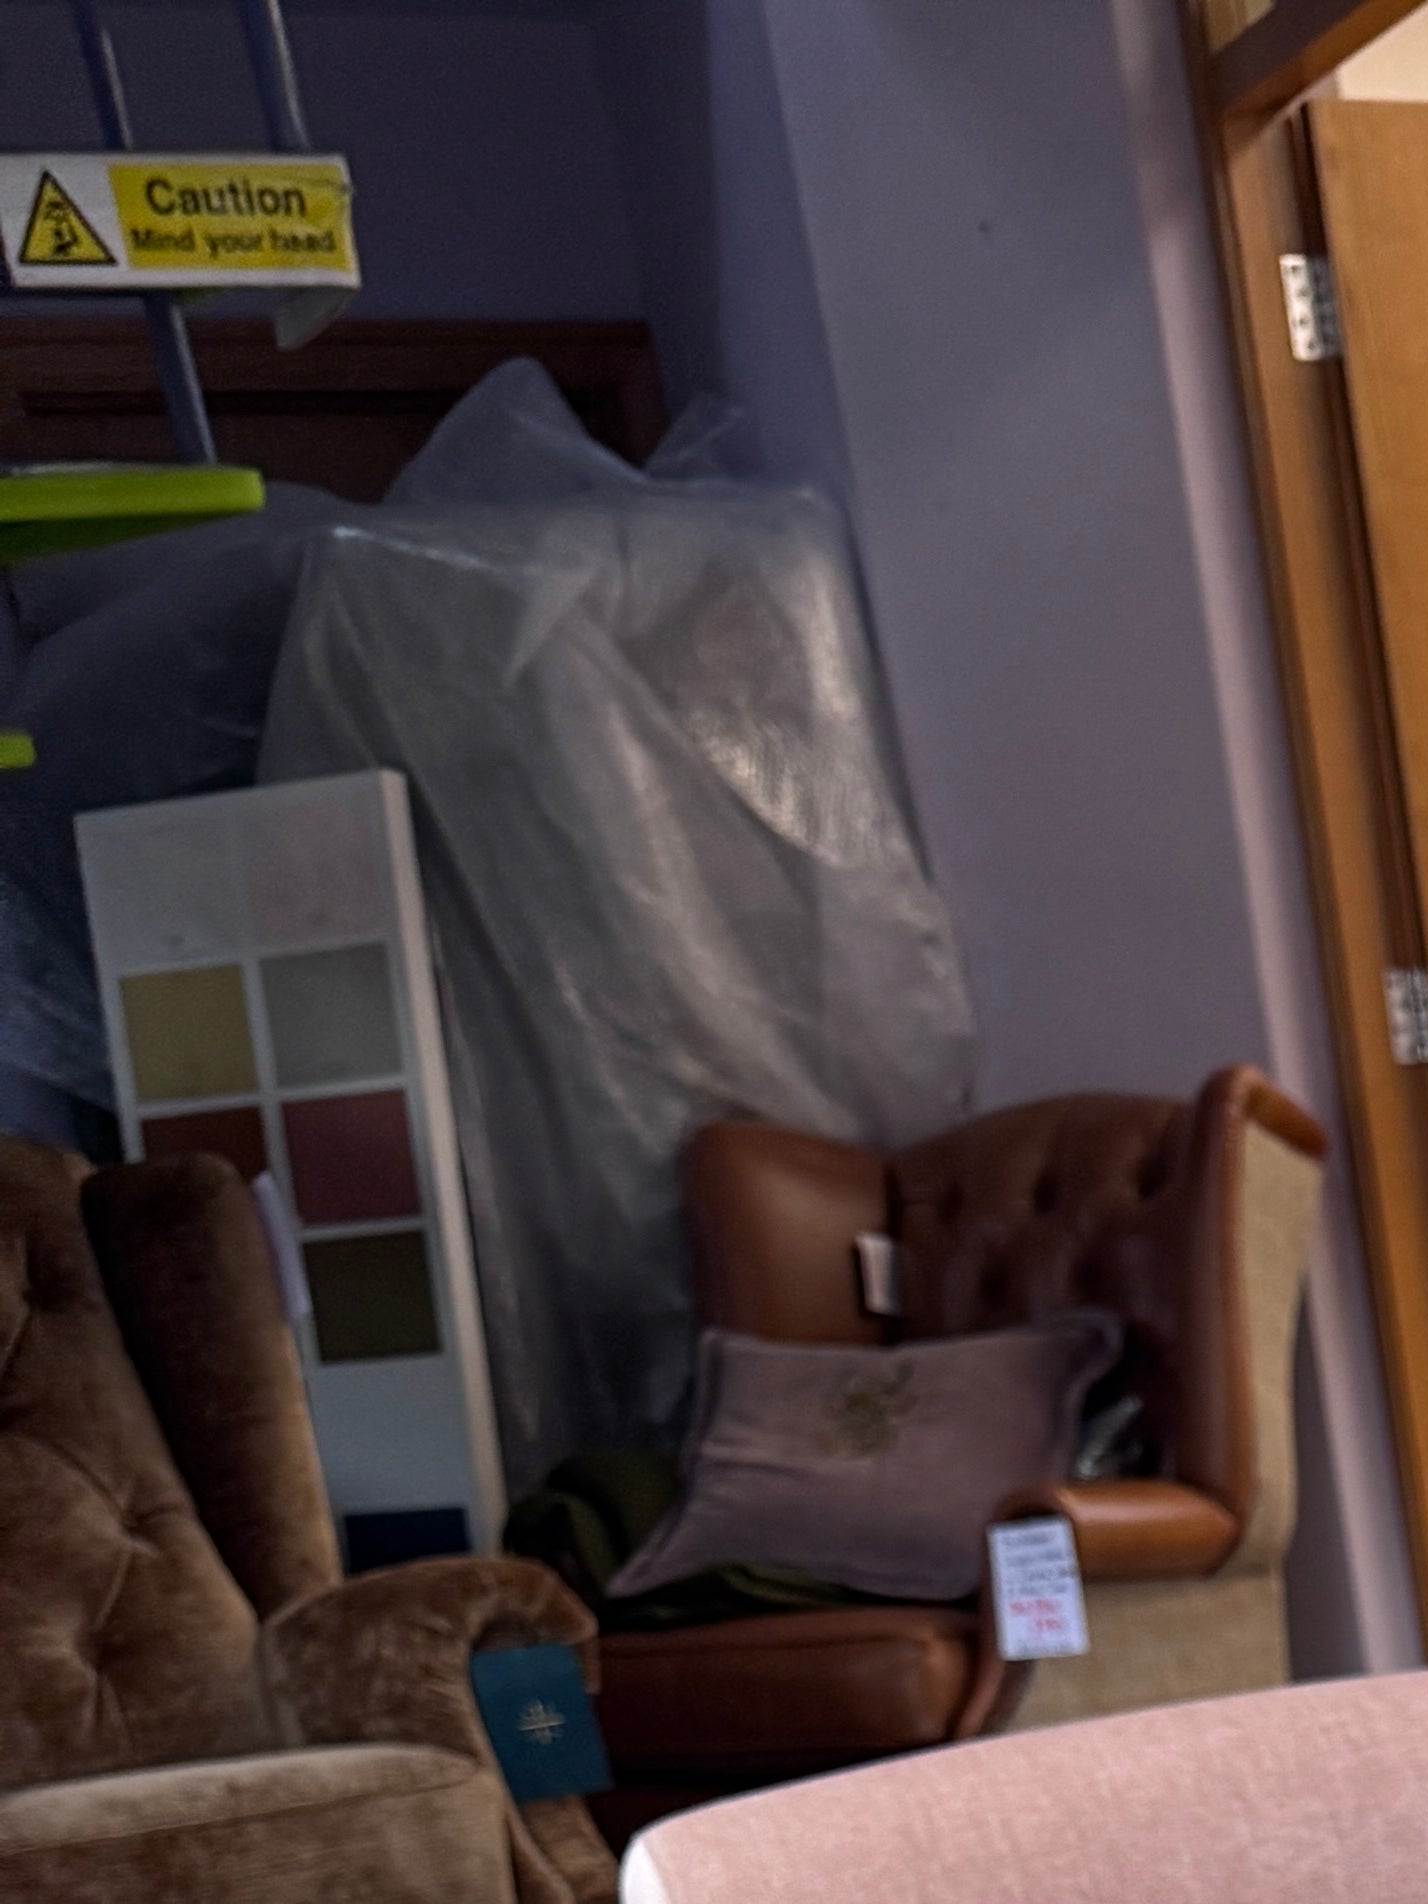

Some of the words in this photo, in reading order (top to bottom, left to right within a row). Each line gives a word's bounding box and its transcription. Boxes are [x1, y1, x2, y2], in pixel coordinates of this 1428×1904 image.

[145, 177, 307, 216] Caution
[205, 232, 264, 259] your
[269, 227, 336, 253] head
